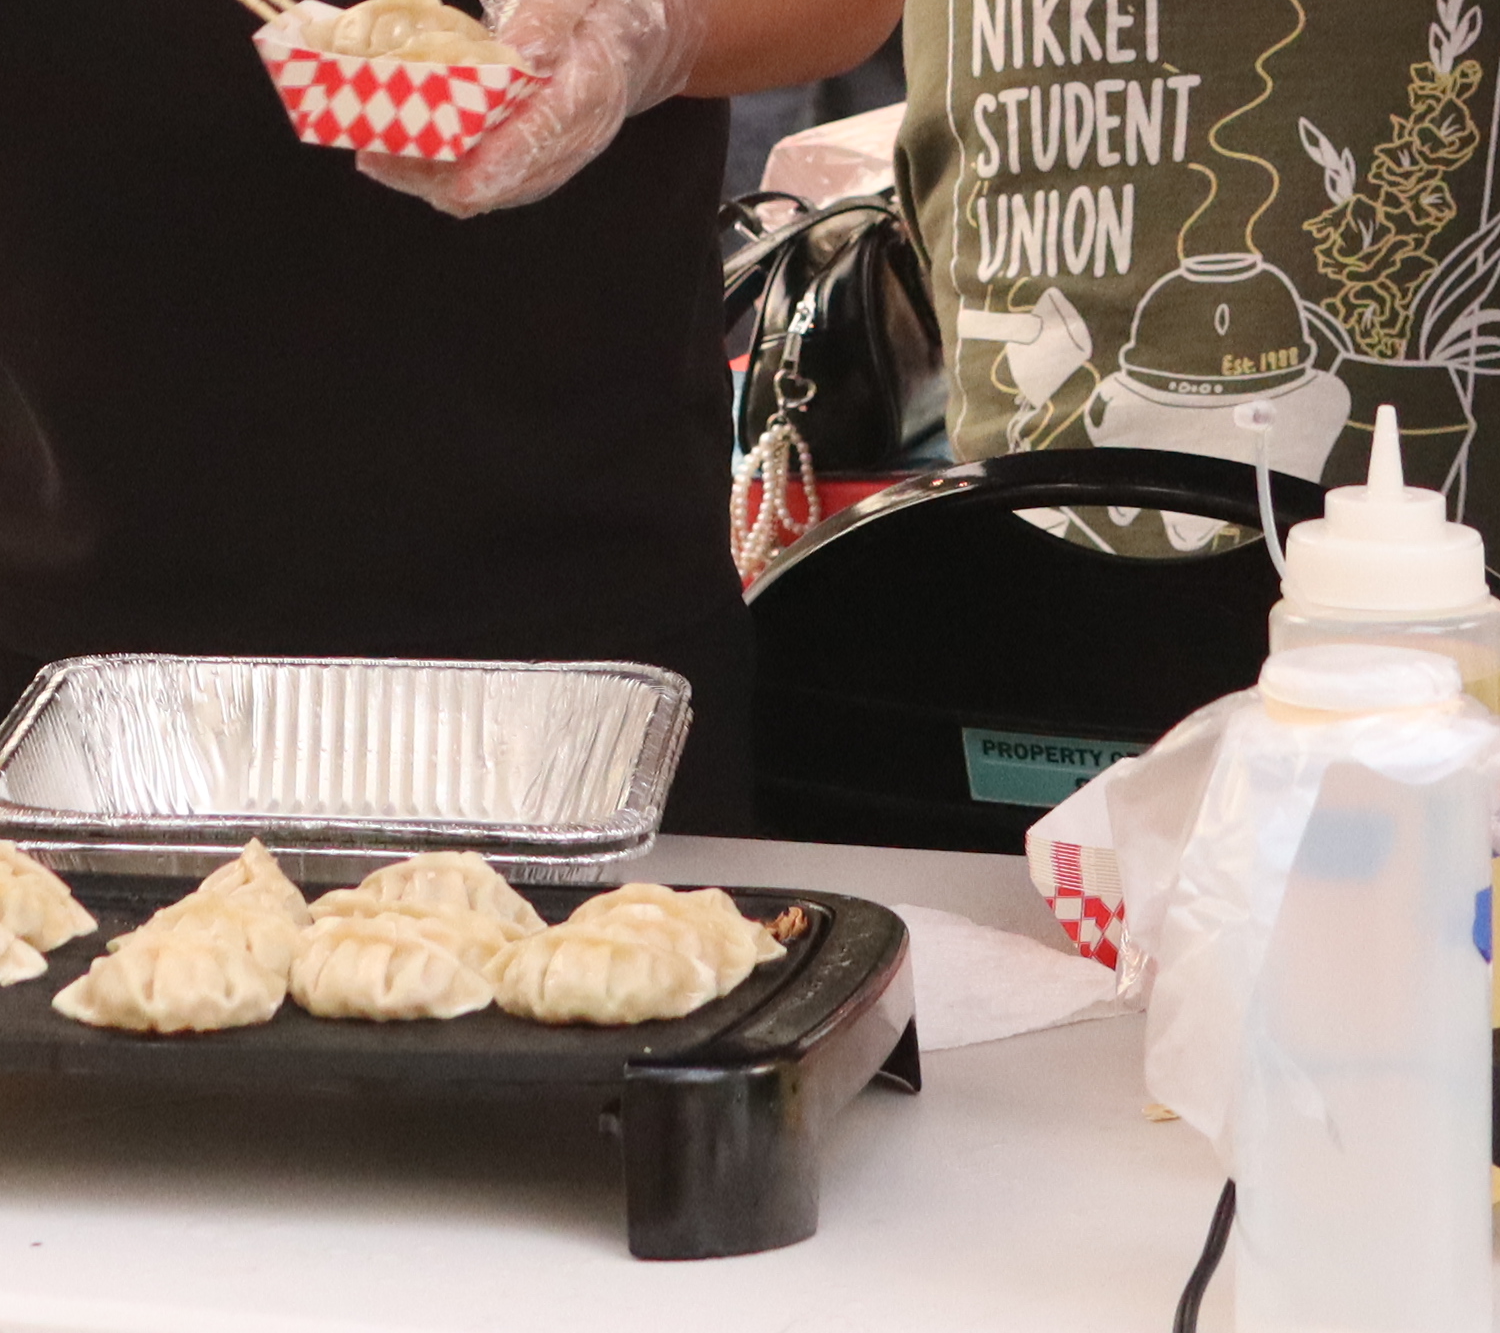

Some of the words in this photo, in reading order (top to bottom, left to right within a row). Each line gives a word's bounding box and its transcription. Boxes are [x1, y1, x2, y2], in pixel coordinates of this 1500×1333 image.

[974, 75, 1202, 179] STUDENT
[976, 183, 1135, 283] UNION
[982, 739, 1103, 766] PROPERTY
